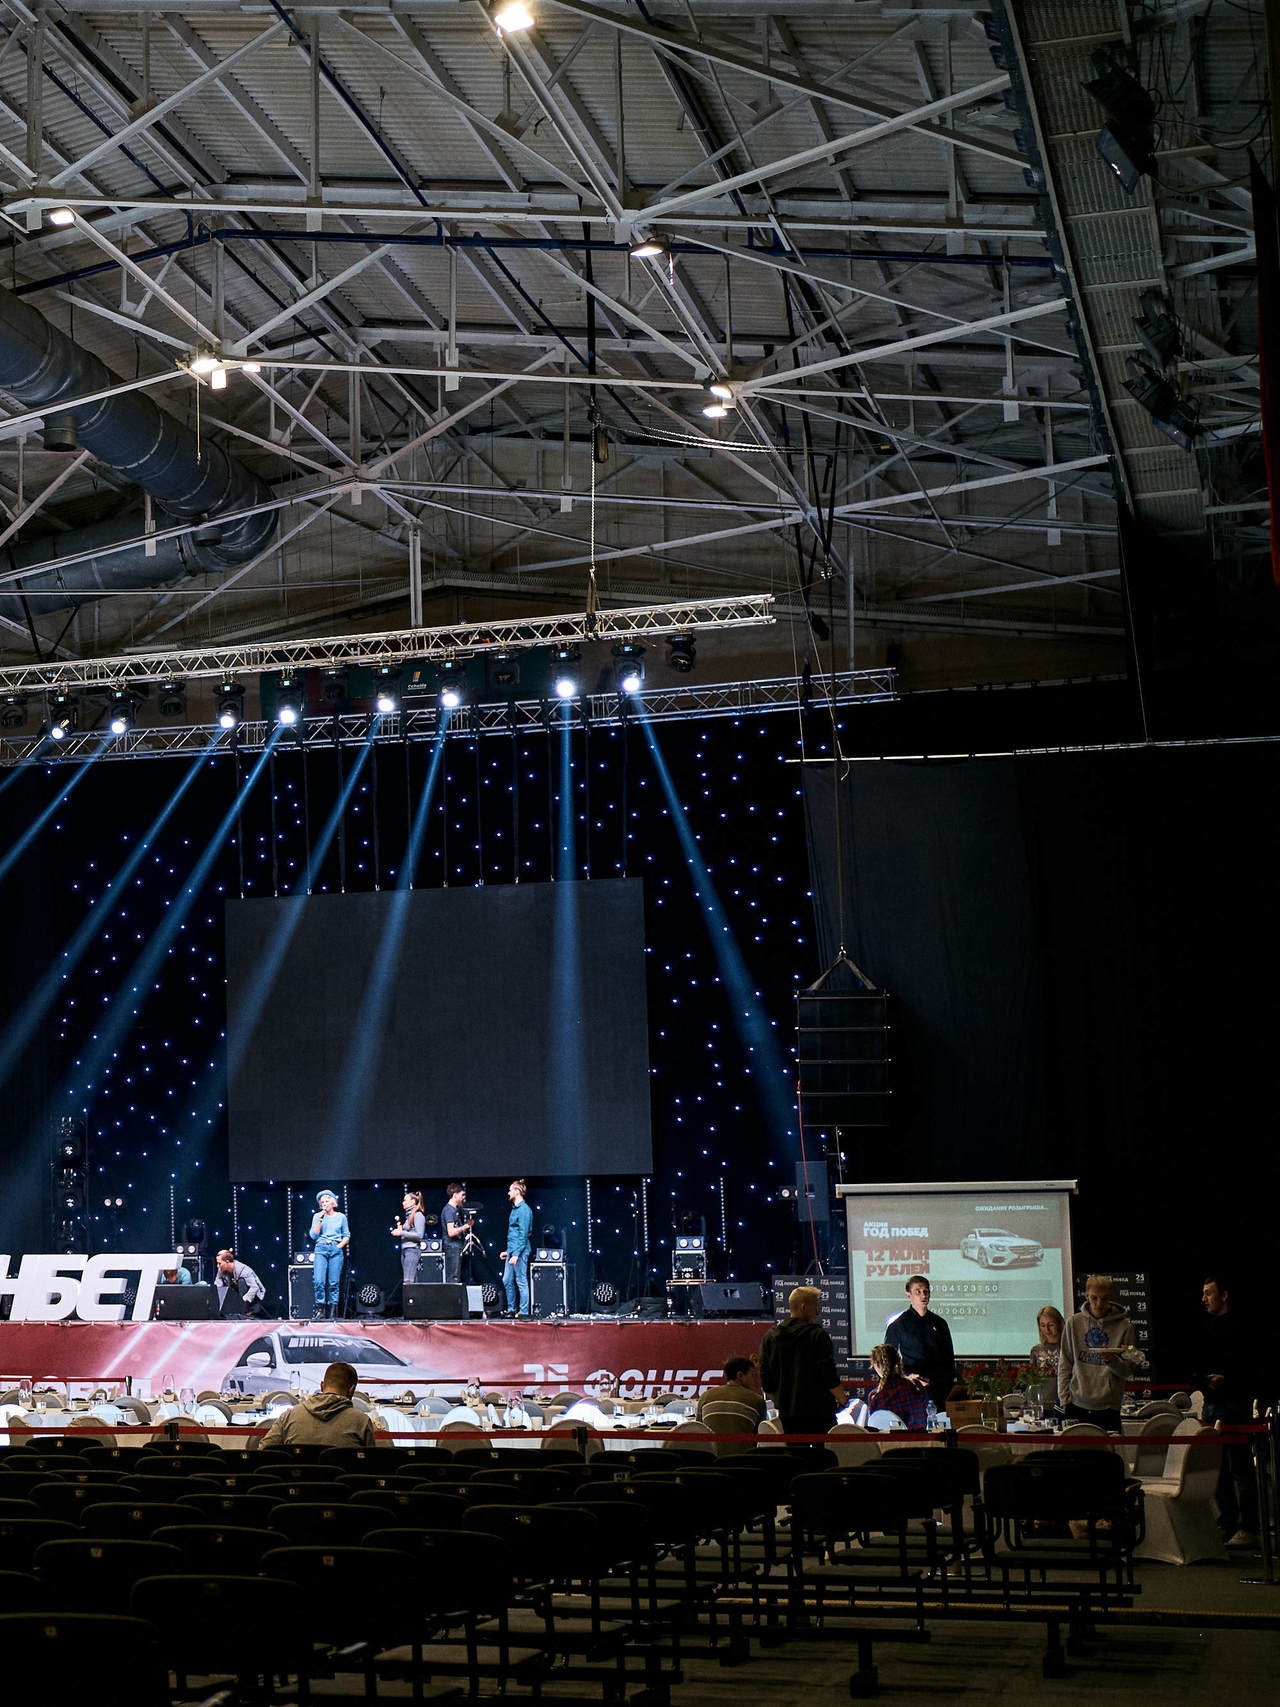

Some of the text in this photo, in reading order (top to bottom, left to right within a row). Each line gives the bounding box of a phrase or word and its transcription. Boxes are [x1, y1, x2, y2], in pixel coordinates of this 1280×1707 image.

[864, 1227, 928, 1238] ГОД ПОБЕД
[866, 1248, 885, 1262] 12
[866, 1261, 930, 1277] РУБЛЕЙ
[583, 1369, 724, 1398] ФОНБЕ
